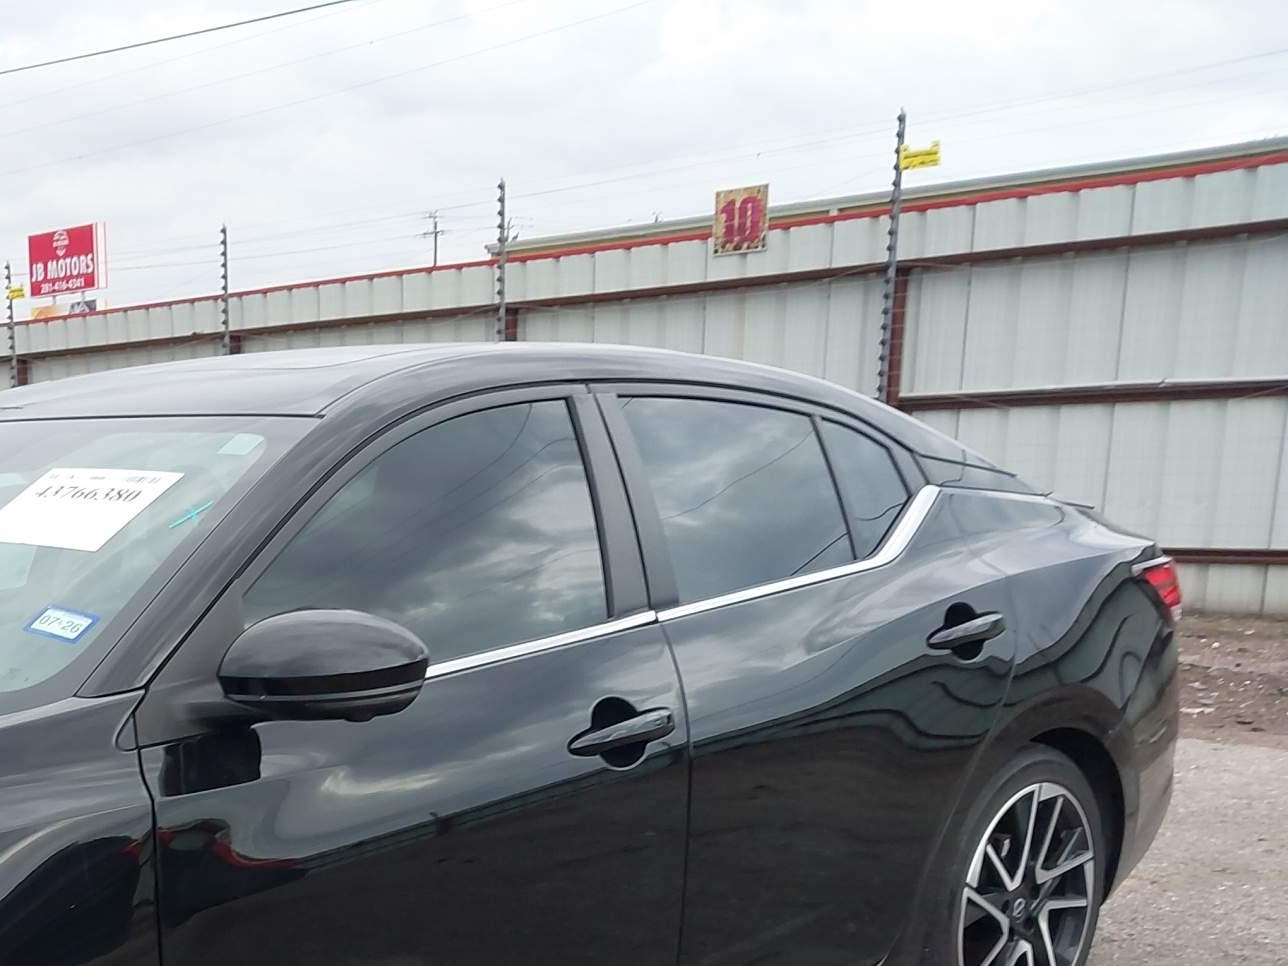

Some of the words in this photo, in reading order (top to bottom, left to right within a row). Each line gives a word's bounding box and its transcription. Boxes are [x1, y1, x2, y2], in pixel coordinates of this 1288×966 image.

[720, 195, 762, 246] 10
[32, 262, 44, 282] JB
[47, 253, 93, 279] MOTORS
[34, 485, 143, 502] 43766380
